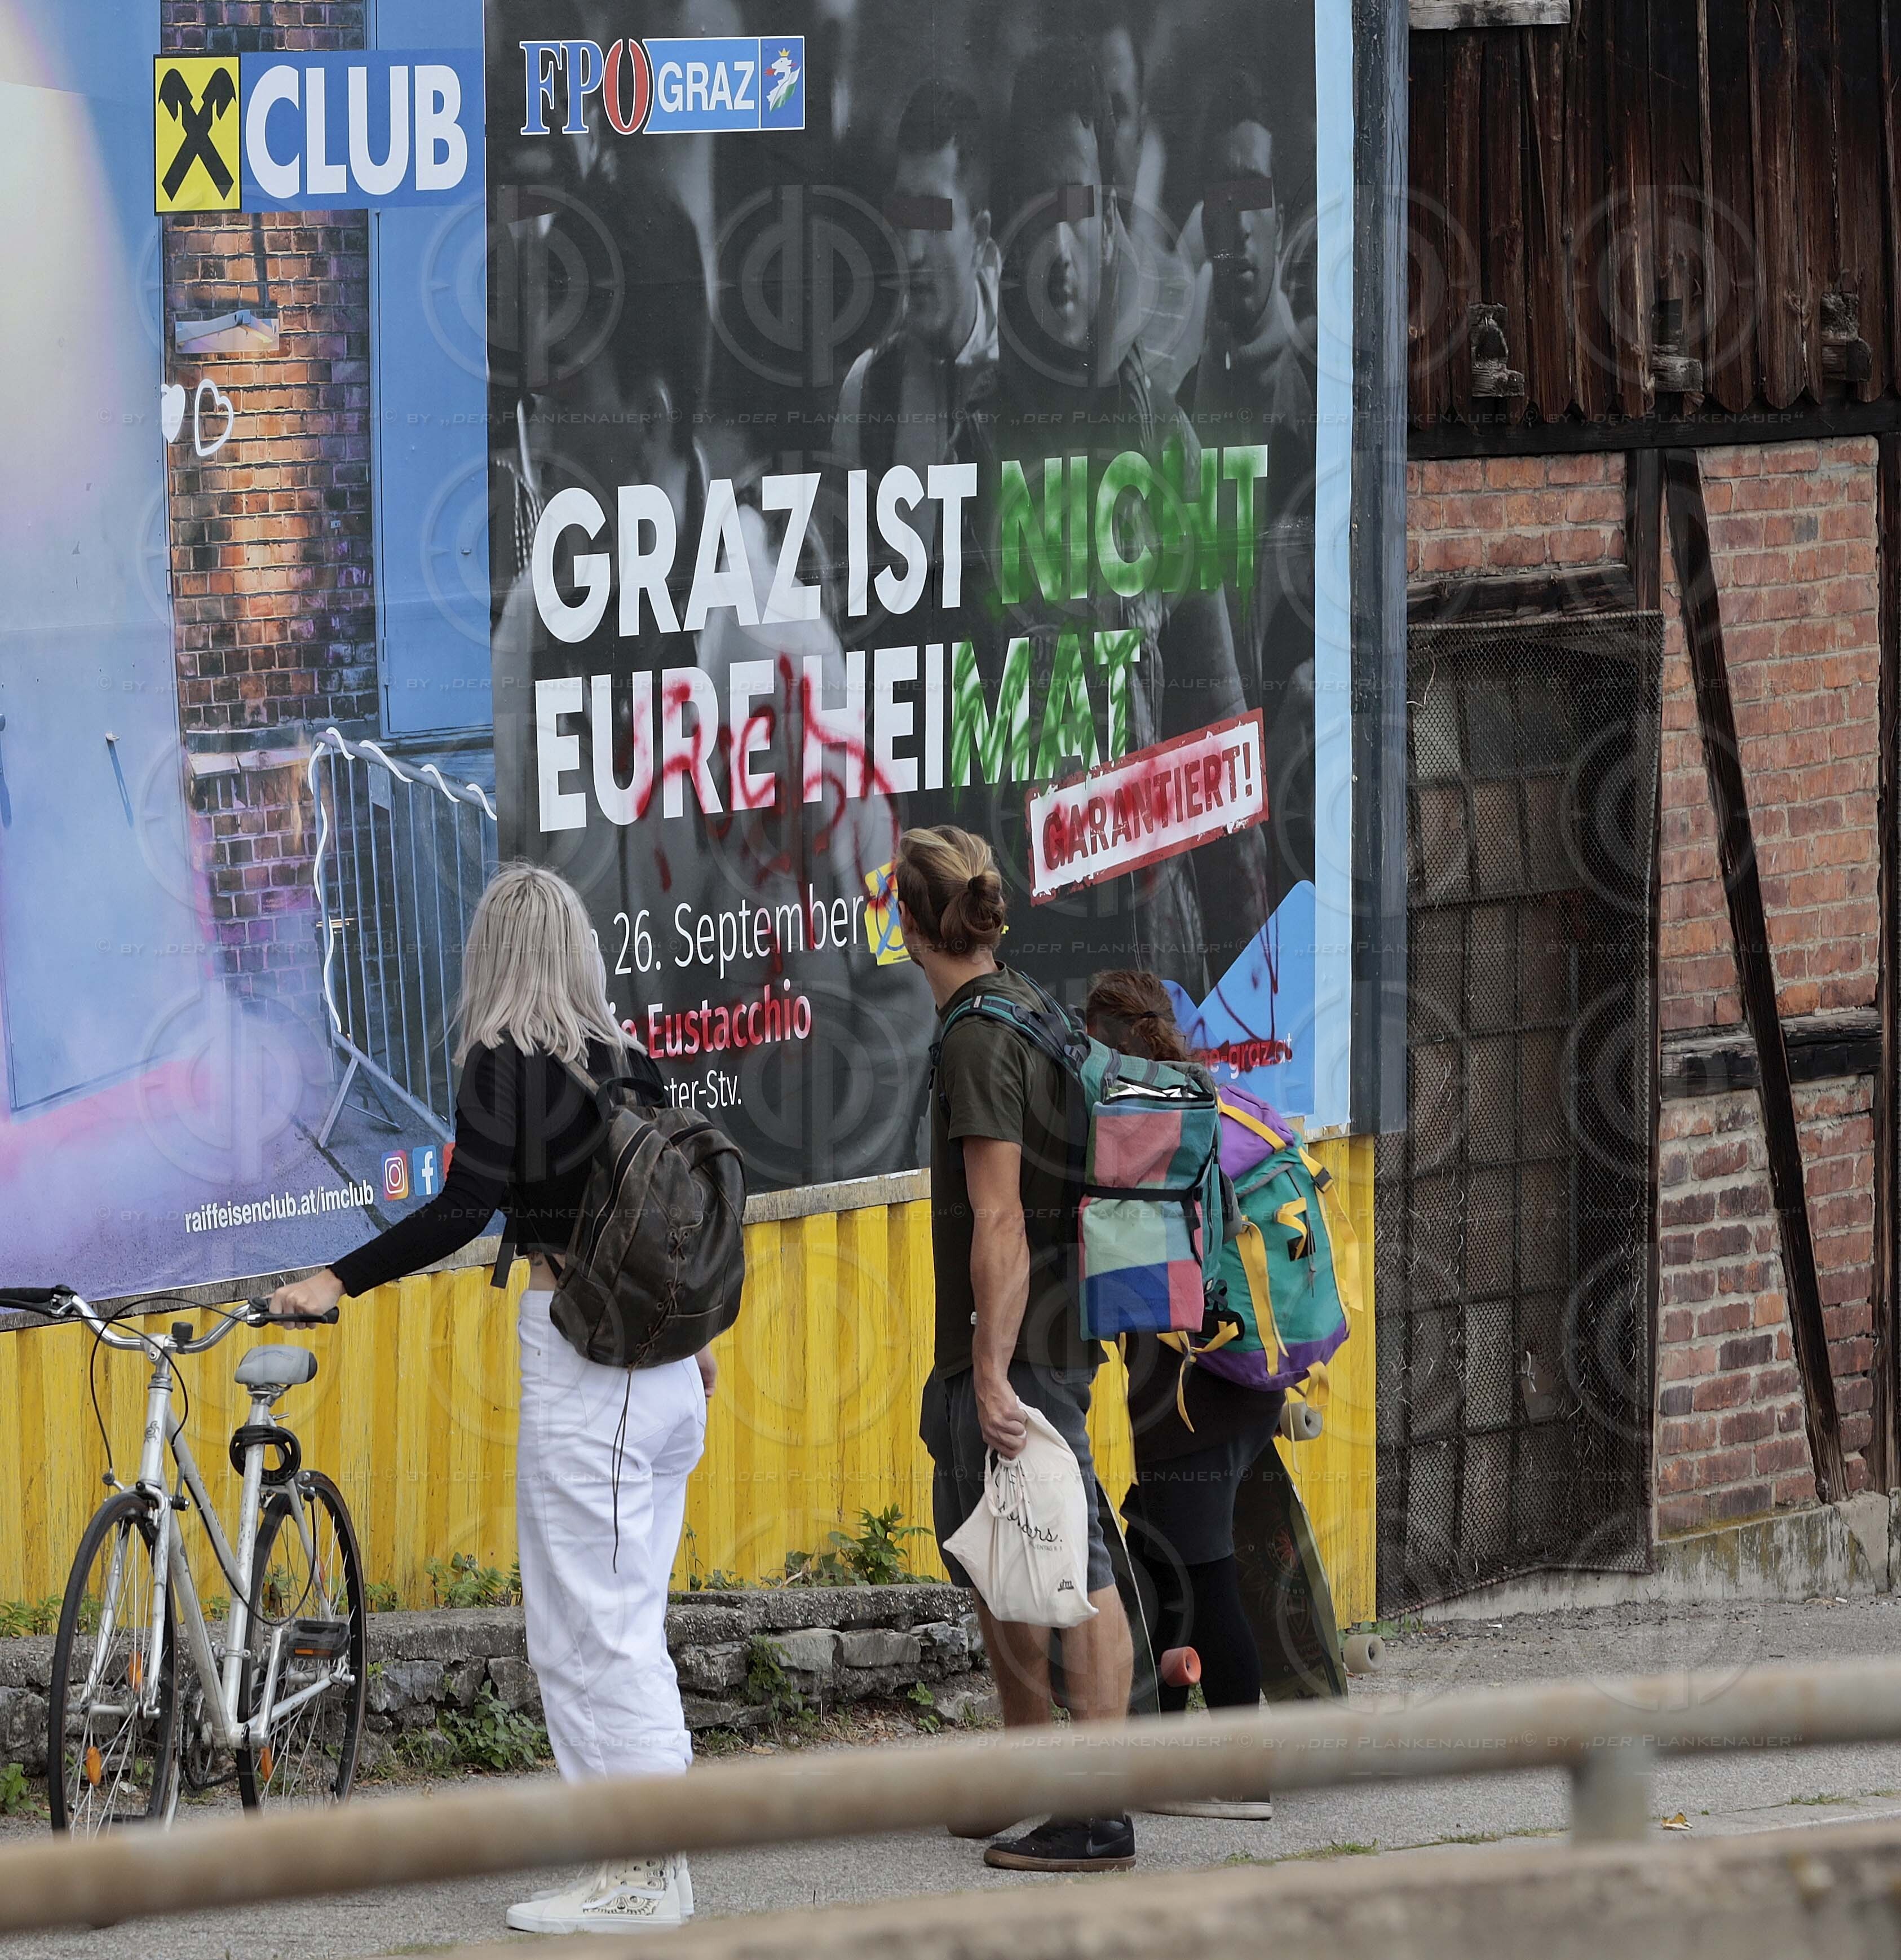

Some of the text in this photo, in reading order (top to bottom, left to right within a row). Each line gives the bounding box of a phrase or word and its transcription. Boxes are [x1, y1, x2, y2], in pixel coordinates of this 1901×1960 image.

[246, 64, 468, 198] CLUB
[657, 60, 754, 113] GRAZ
[532, 444, 1268, 643] GRAZ IST NICHT
[535, 659, 776, 833] EURE
[803, 630, 1141, 804] HEIMAT
[1042, 741, 1252, 871] GARANTIERT!
[613, 883, 864, 979] 26. September
[647, 978, 811, 1060] Eustacchio
[184, 1180, 374, 1233] raiffeisenclub.at/imclub
